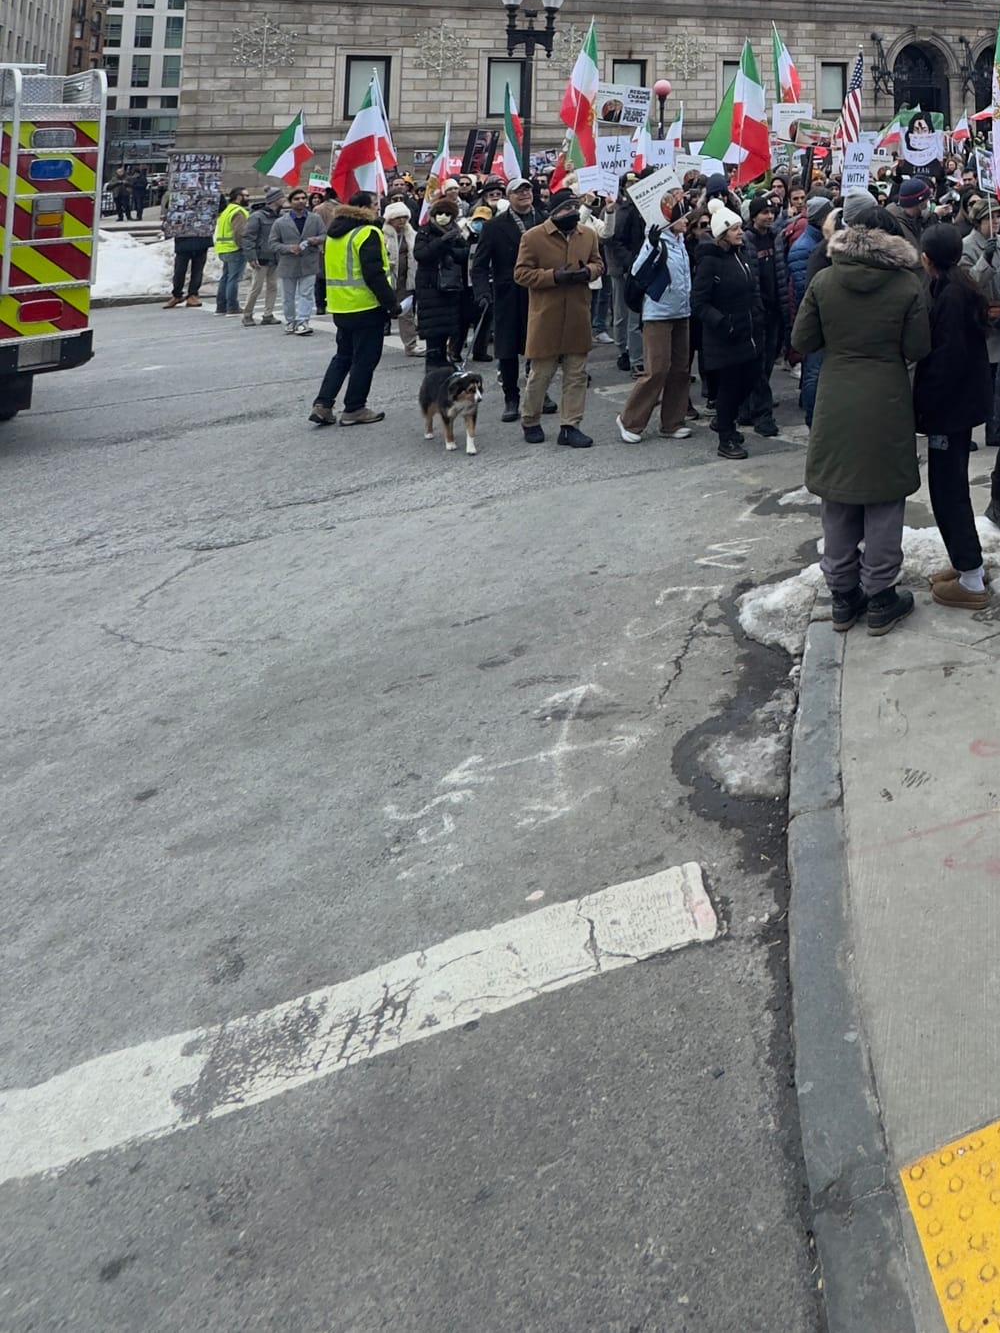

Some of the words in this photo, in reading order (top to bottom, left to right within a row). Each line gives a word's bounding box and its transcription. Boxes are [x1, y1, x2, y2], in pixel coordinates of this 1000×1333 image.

[607, 144, 621, 153] WE
[853, 152, 865, 163] NO
[600, 159, 627, 170] WANT
[847, 173, 866, 183] WITH
